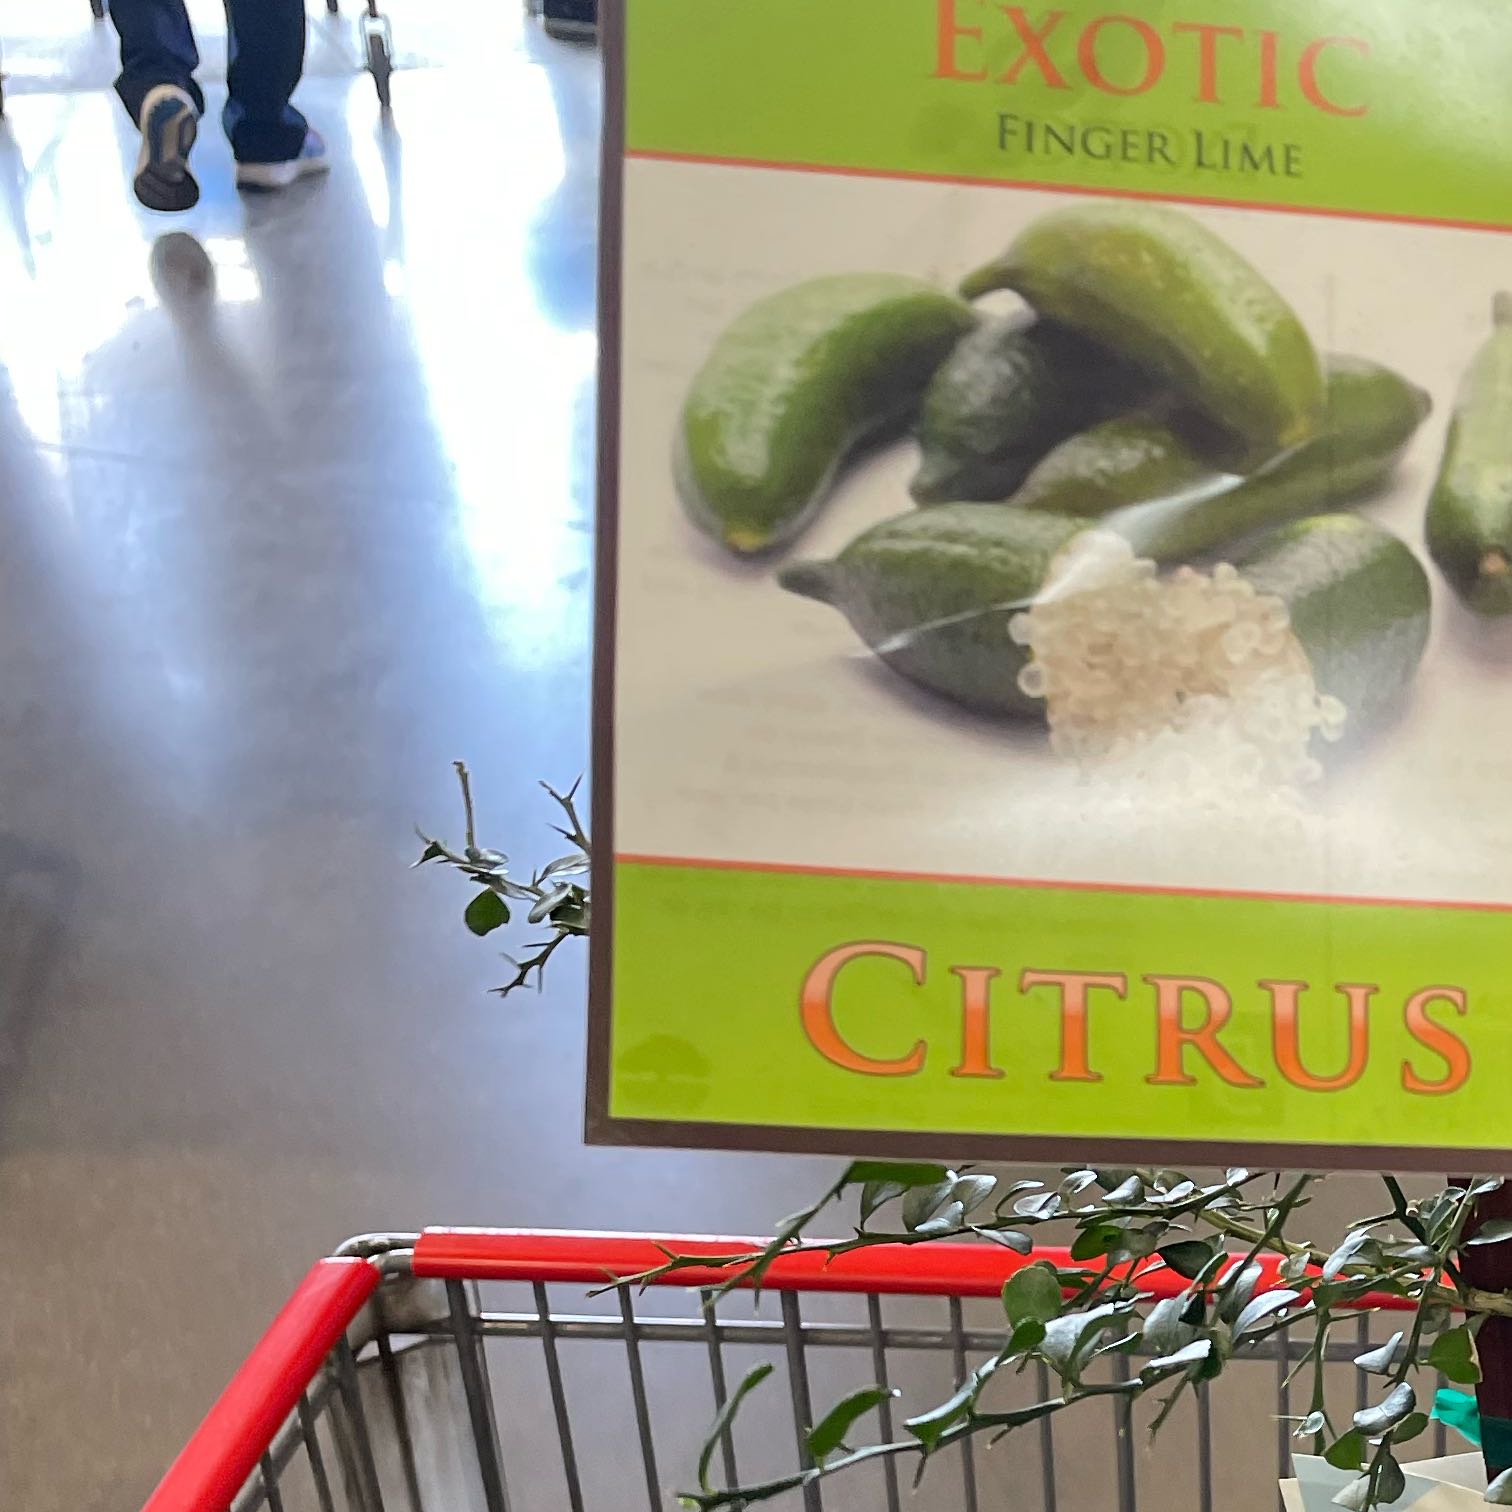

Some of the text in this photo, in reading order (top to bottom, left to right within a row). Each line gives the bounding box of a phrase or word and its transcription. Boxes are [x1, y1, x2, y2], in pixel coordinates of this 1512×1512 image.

[930, 0, 1373, 118] EXOTIC
[996, 112, 1304, 178] FINGER LIME
[799, 940, 1472, 1096] CITRUS
